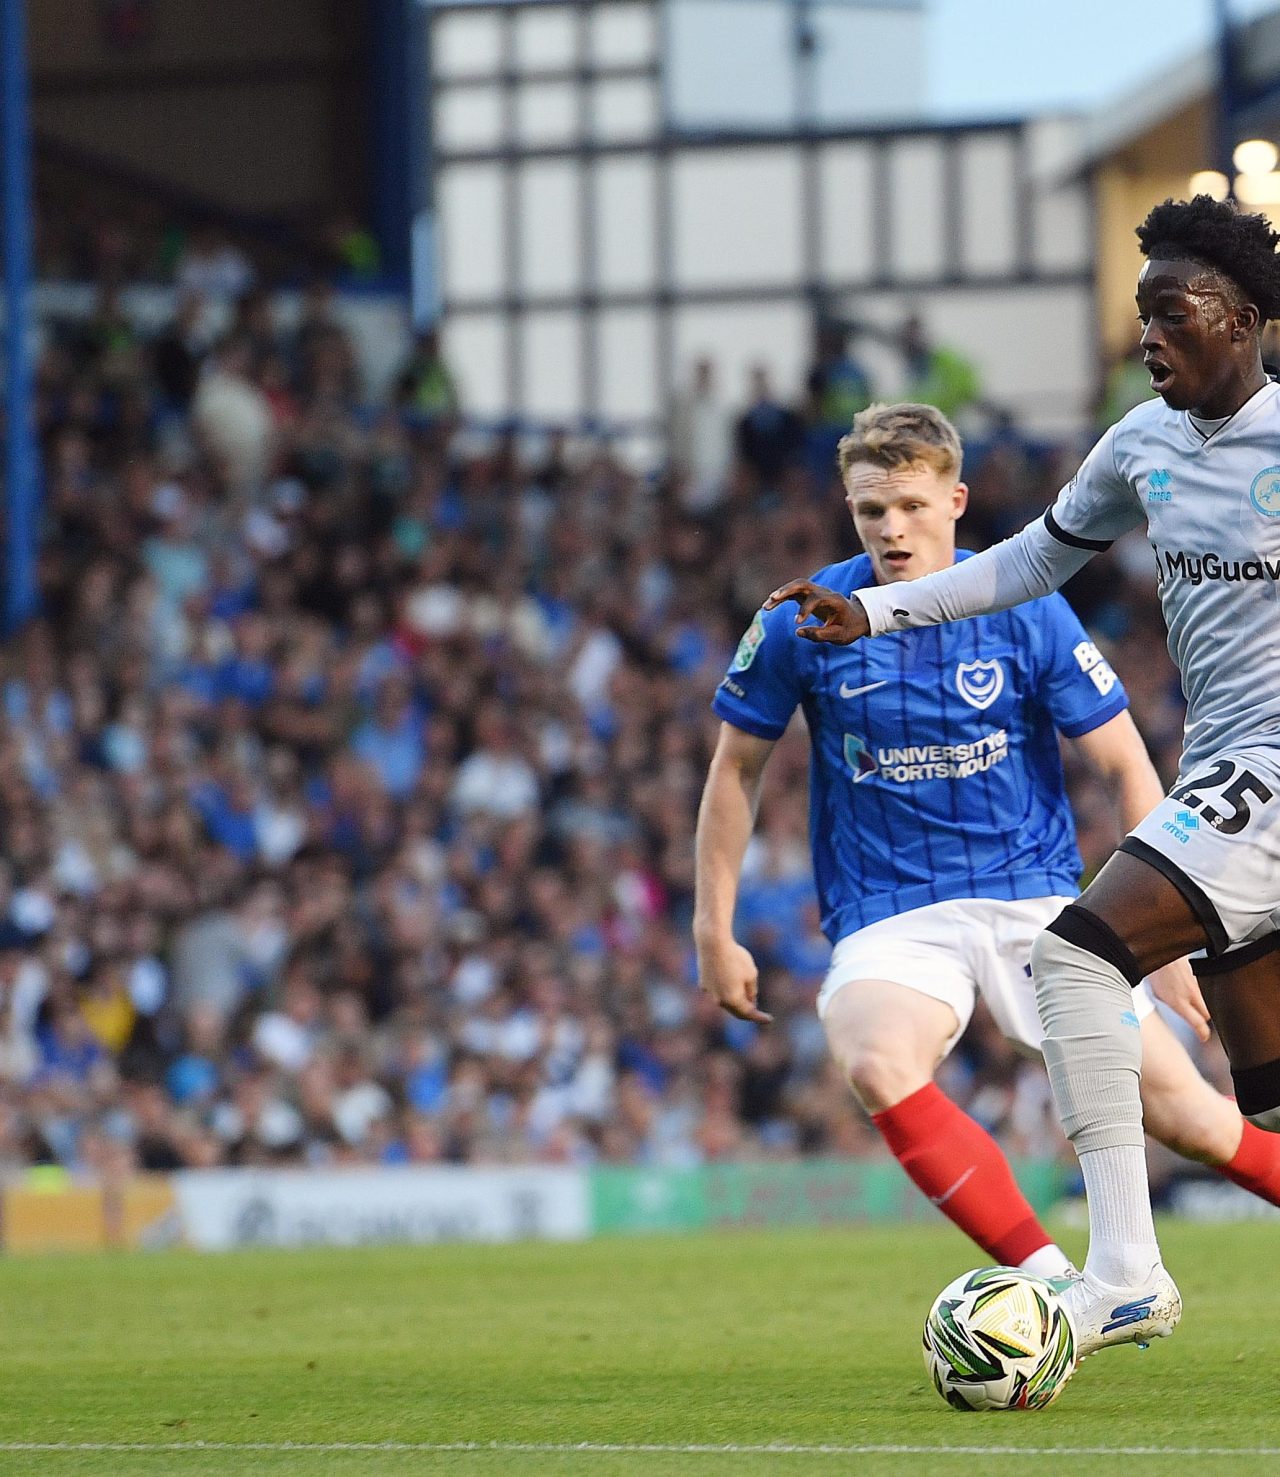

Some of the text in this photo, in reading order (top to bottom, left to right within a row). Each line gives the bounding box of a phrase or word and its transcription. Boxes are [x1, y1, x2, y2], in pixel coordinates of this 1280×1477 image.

[878, 732, 998, 765] UNIVERSITY
[881, 746, 1008, 783] PORTSMOUTH
[1170, 760, 1273, 835] 25
